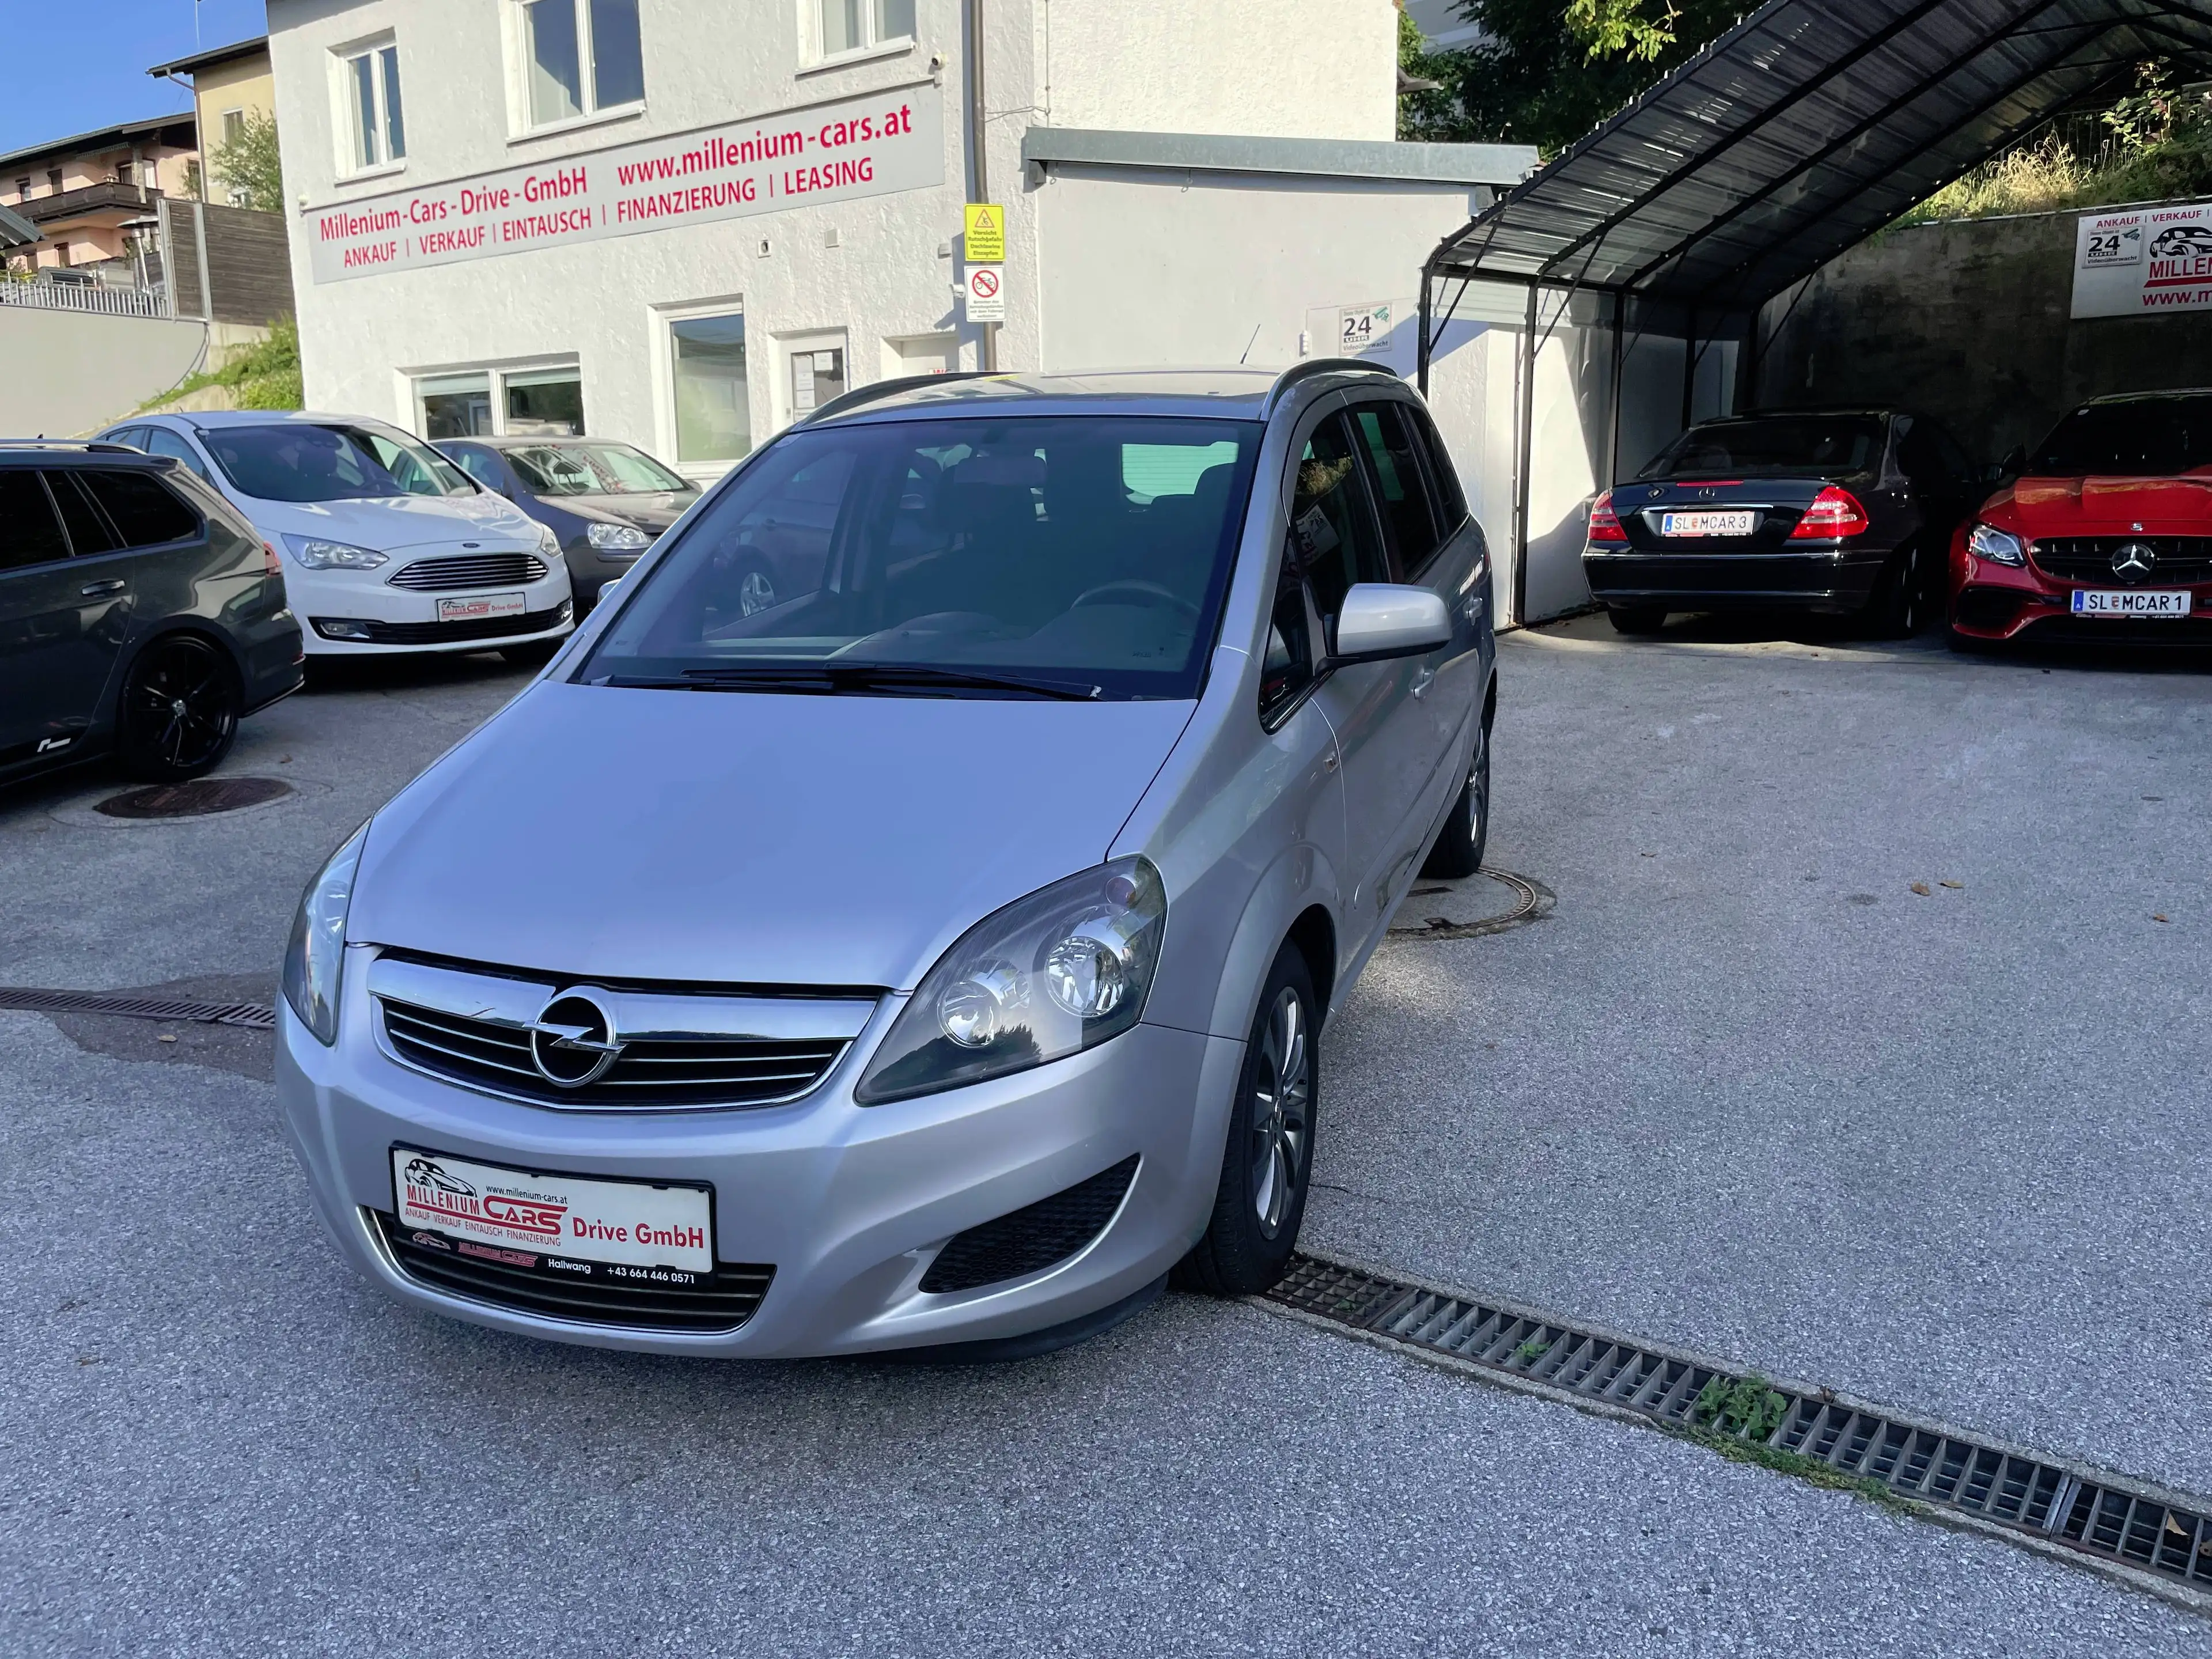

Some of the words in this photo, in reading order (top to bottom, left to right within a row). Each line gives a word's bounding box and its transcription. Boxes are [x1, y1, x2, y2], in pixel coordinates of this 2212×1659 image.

[618, 104, 912, 186] www.millenium-cars.at
[344, 241, 397, 268] ANKAUF
[419, 226, 486, 255] VERKAUF
[503, 209, 592, 242] EINTAUSCH
[618, 178, 756, 223] FINANZIERUNG
[784, 157, 873, 196] LEASING
[2096, 217, 2141, 228] ANKAUF
[2152, 210, 2202, 222] VERKAUF
[2089, 235, 2120, 252] 24
[1343, 316, 1372, 336] 24
[1343, 341, 1388, 350] Videoüberwacht
[1675, 517, 1690, 529] SL
[1700, 516, 1736, 529] MCAR
[1739, 516, 1747, 528] 3
[2089, 594, 2107, 609] SL
[2122, 595, 2170, 611] MCAR
[2174, 596, 2181, 610] 1
[407, 1184, 480, 1215] MILLENIUM
[486, 1185, 568, 1205] www.millenium-cars.at
[405, 1207, 430, 1221] ANKAUF
[433, 1214, 461, 1229] VERKAUF
[465, 1221, 503, 1237] EINTAUSCH
[507, 1229, 561, 1247] FINANZIERUNG
[573, 1217, 627, 1242] Drive
[635, 1223, 703, 1248] GmbH
[548, 1258, 591, 1274] Hallwang
[607, 1267, 627, 1277] +43
[629, 1268, 647, 1279] 664
[650, 1272, 668, 1281] 446
[671, 1273, 694, 1284] 0571
